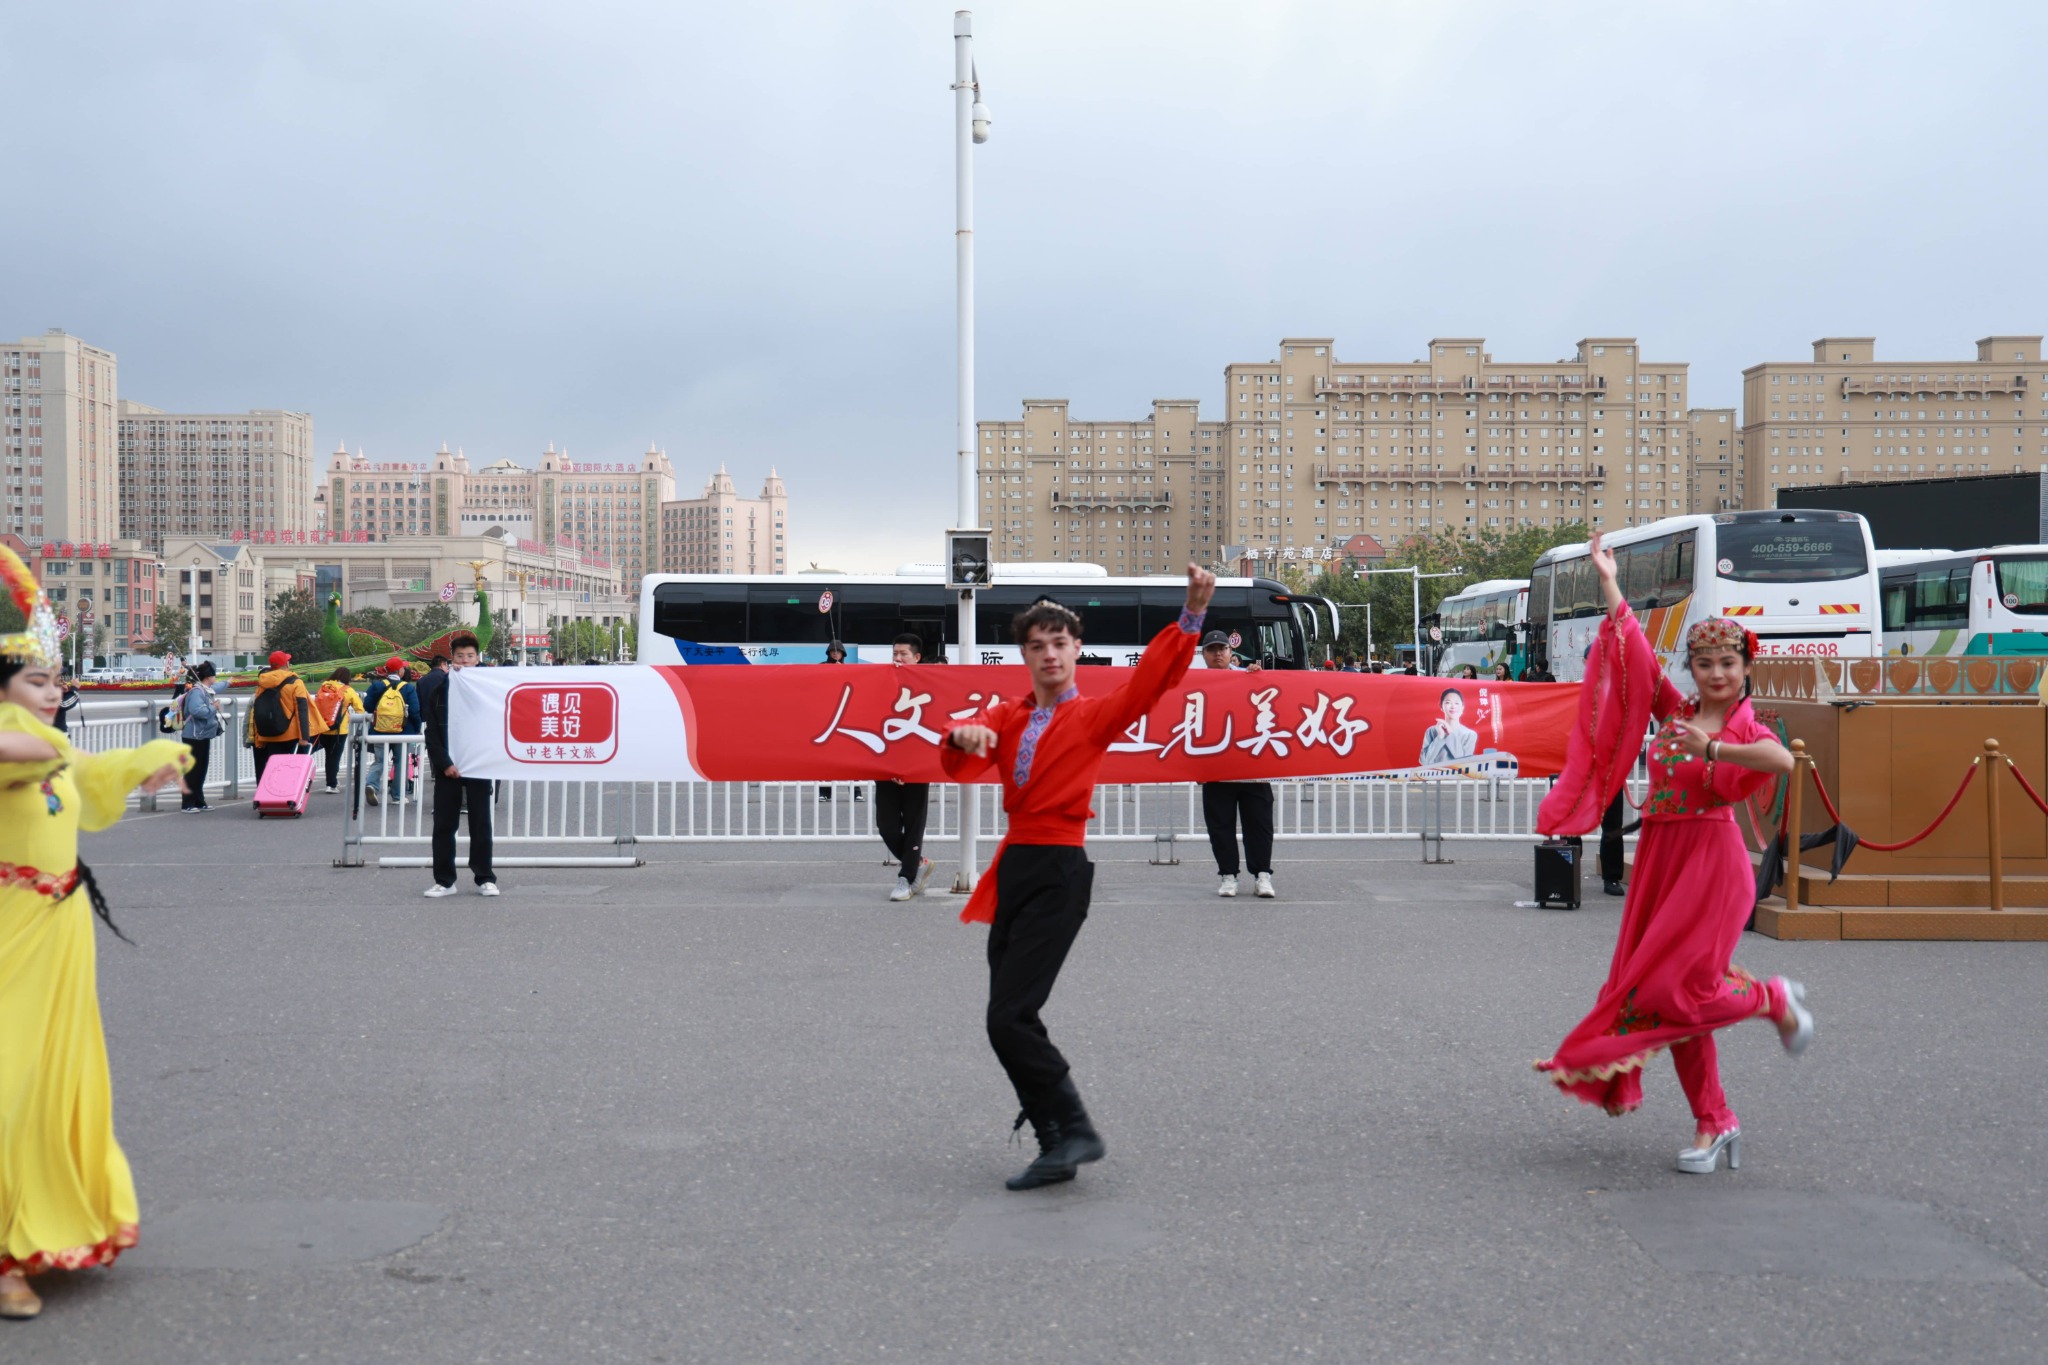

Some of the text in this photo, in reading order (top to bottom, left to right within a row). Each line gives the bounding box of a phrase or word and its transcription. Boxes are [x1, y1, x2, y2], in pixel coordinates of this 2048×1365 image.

[231, 529, 369, 544] 伊宁跨境电商产业园
[1752, 542, 1832, 553] 400-659-6666
[442, 587, 454, 597] 05
[541, 693, 581, 714] 遇见
[541, 716, 581, 738] 美好
[526, 745, 597, 759] 中老年文旅
